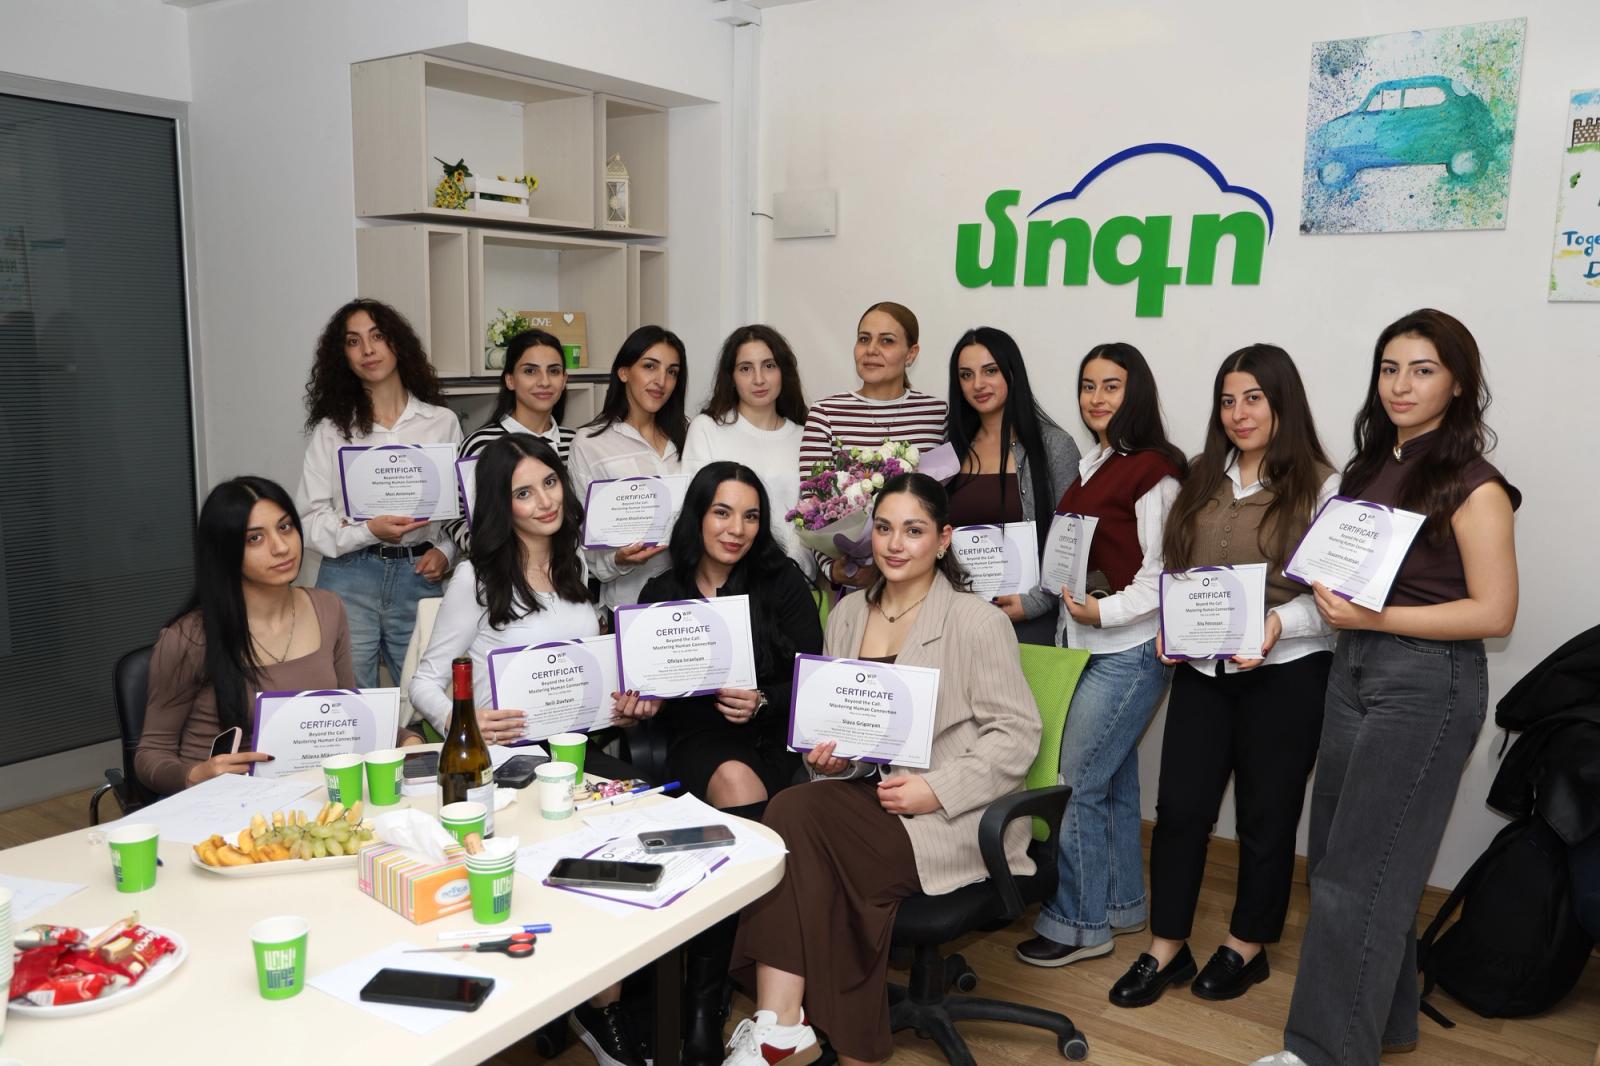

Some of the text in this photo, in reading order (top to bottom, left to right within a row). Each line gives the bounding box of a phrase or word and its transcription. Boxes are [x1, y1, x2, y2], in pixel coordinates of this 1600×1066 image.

[1339, 523, 1379, 539] CERTIFICATE
[959, 547, 1003, 555] CERTIFICATE
[1189, 591, 1231, 599] CERTIFICATE
[656, 625, 710, 636] CERTIFICATE
[532, 666, 584, 679] CERTIFICATE
[836, 687, 893, 700] CERTIFICATE
[300, 719, 358, 729] CERTIFICATE
